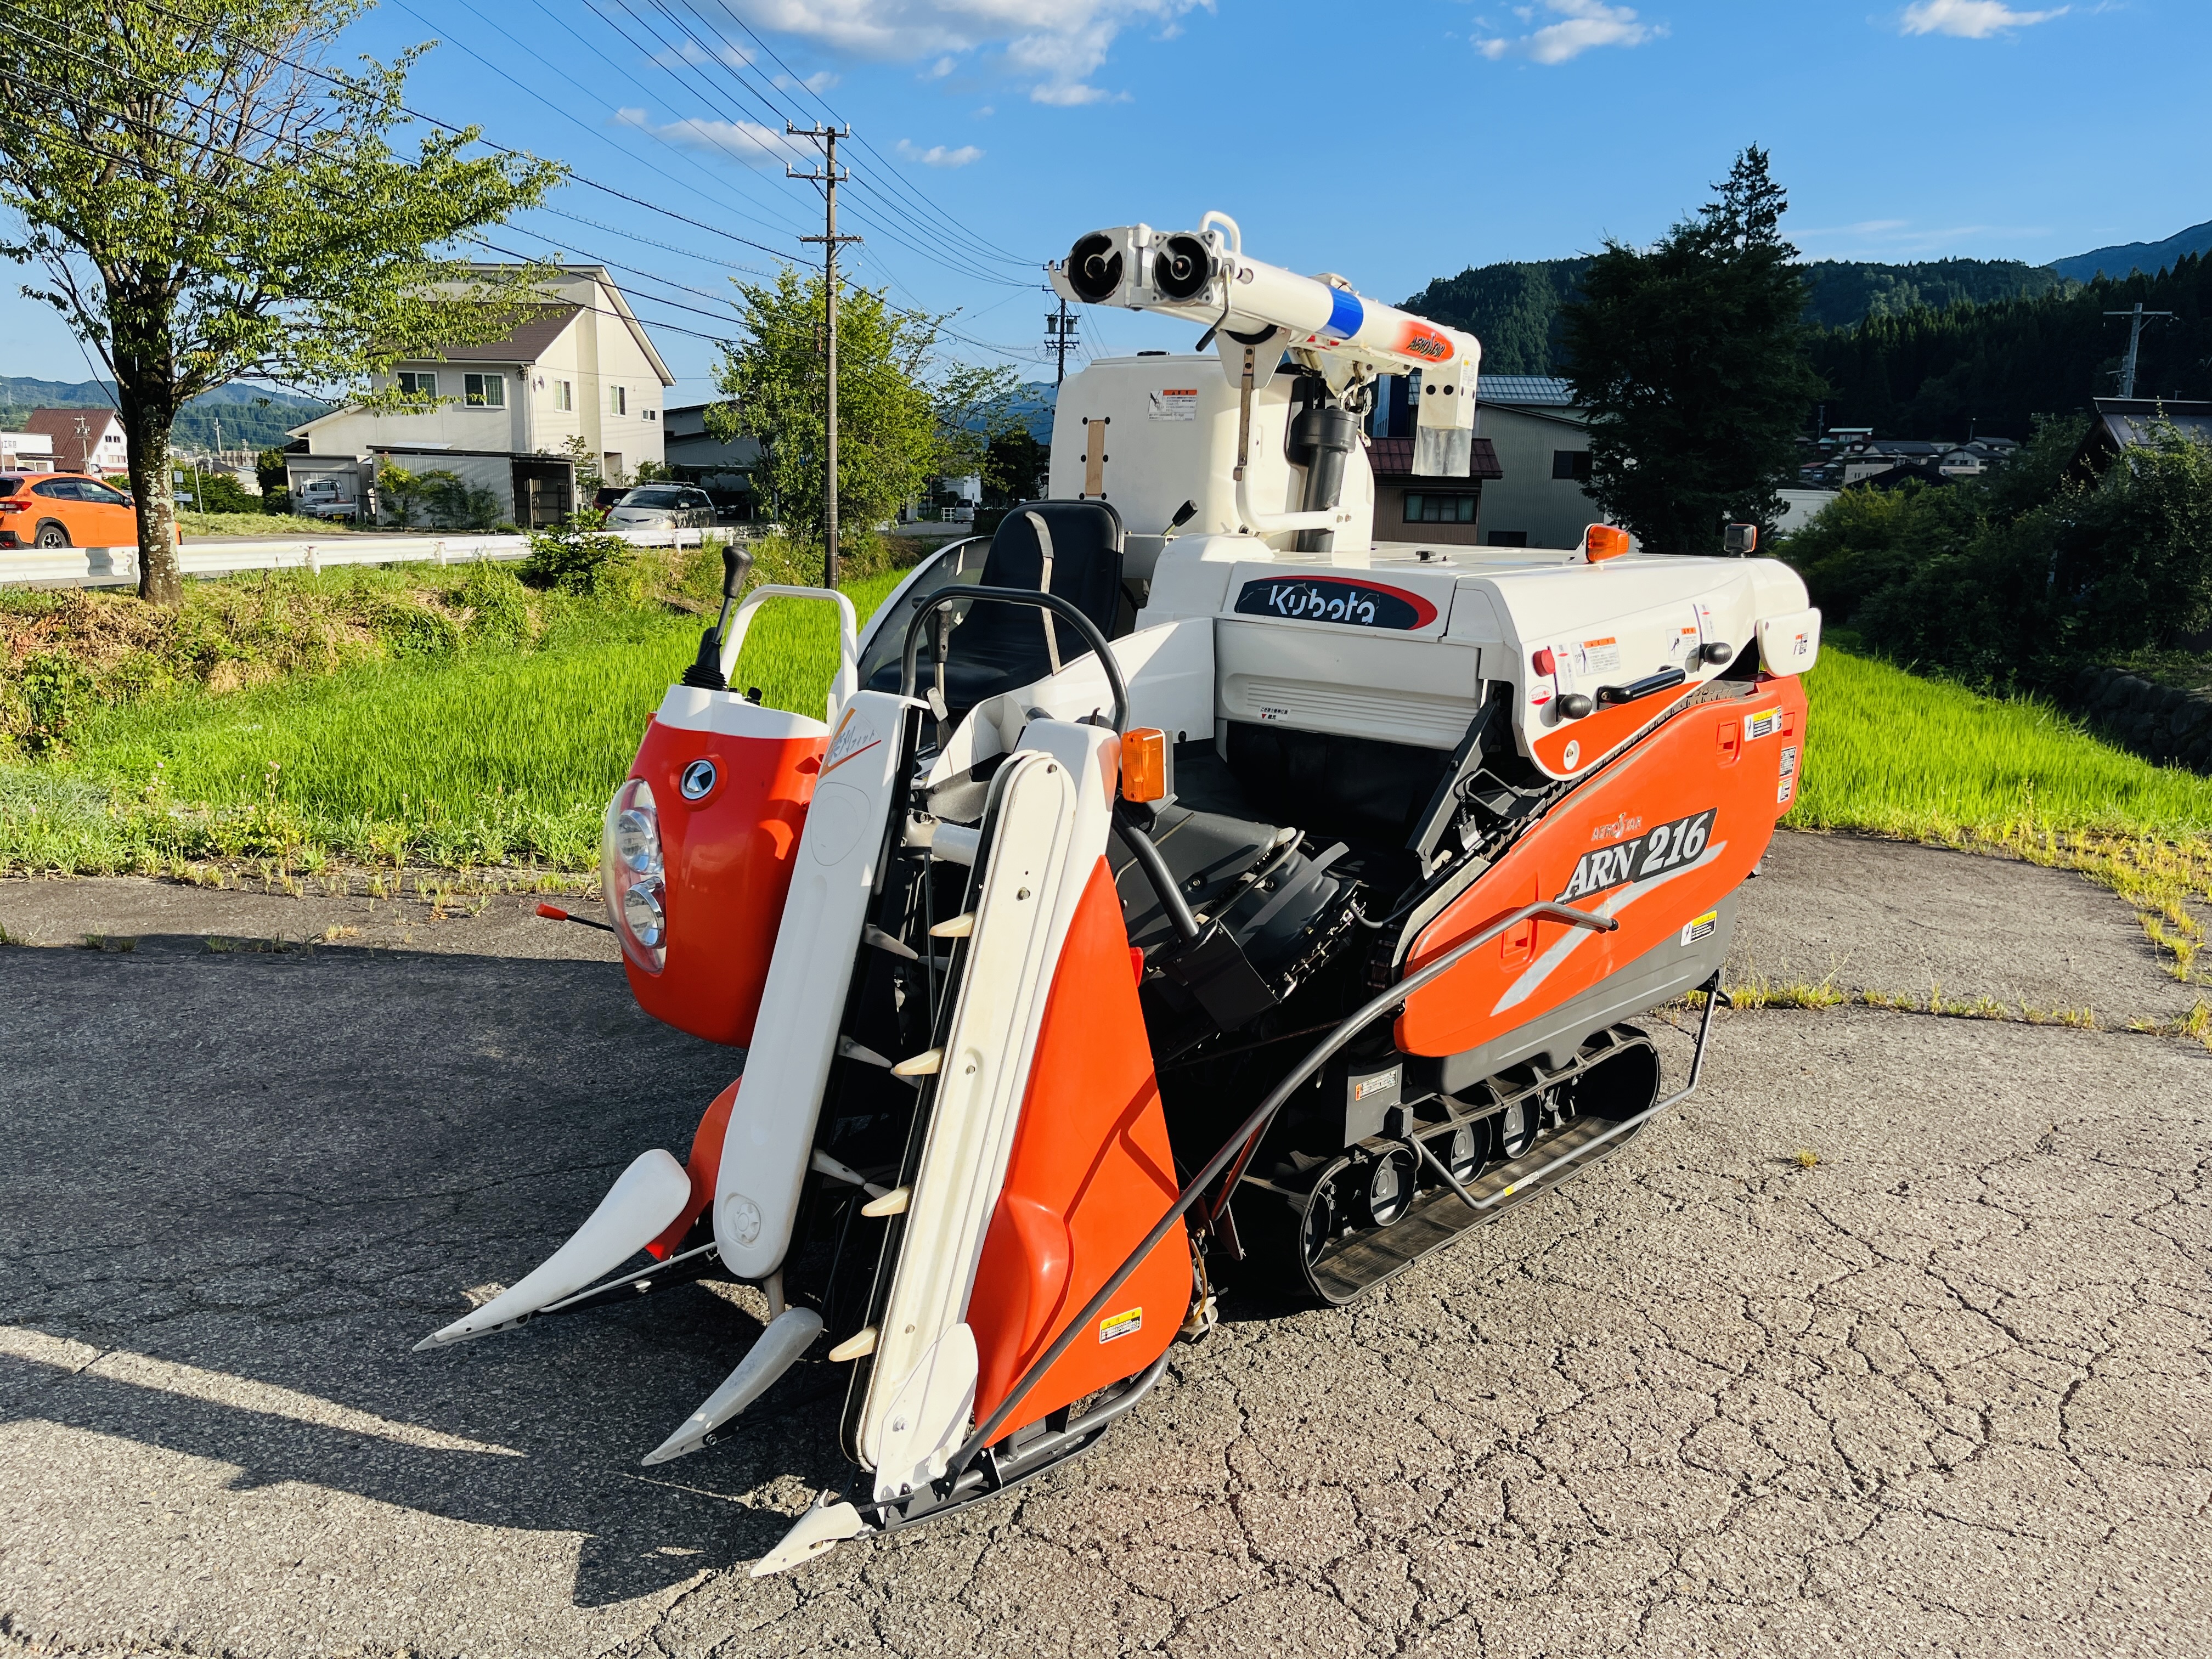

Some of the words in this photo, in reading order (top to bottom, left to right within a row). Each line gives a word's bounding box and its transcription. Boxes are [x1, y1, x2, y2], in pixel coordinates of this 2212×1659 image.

[1406, 332, 1445, 357] AEROSTAR
[1268, 585, 1375, 624] Kubota
[1590, 812, 1642, 841] AEROSTAR
[1555, 840, 1641, 904] ARN
[1639, 812, 1710, 876] 216
